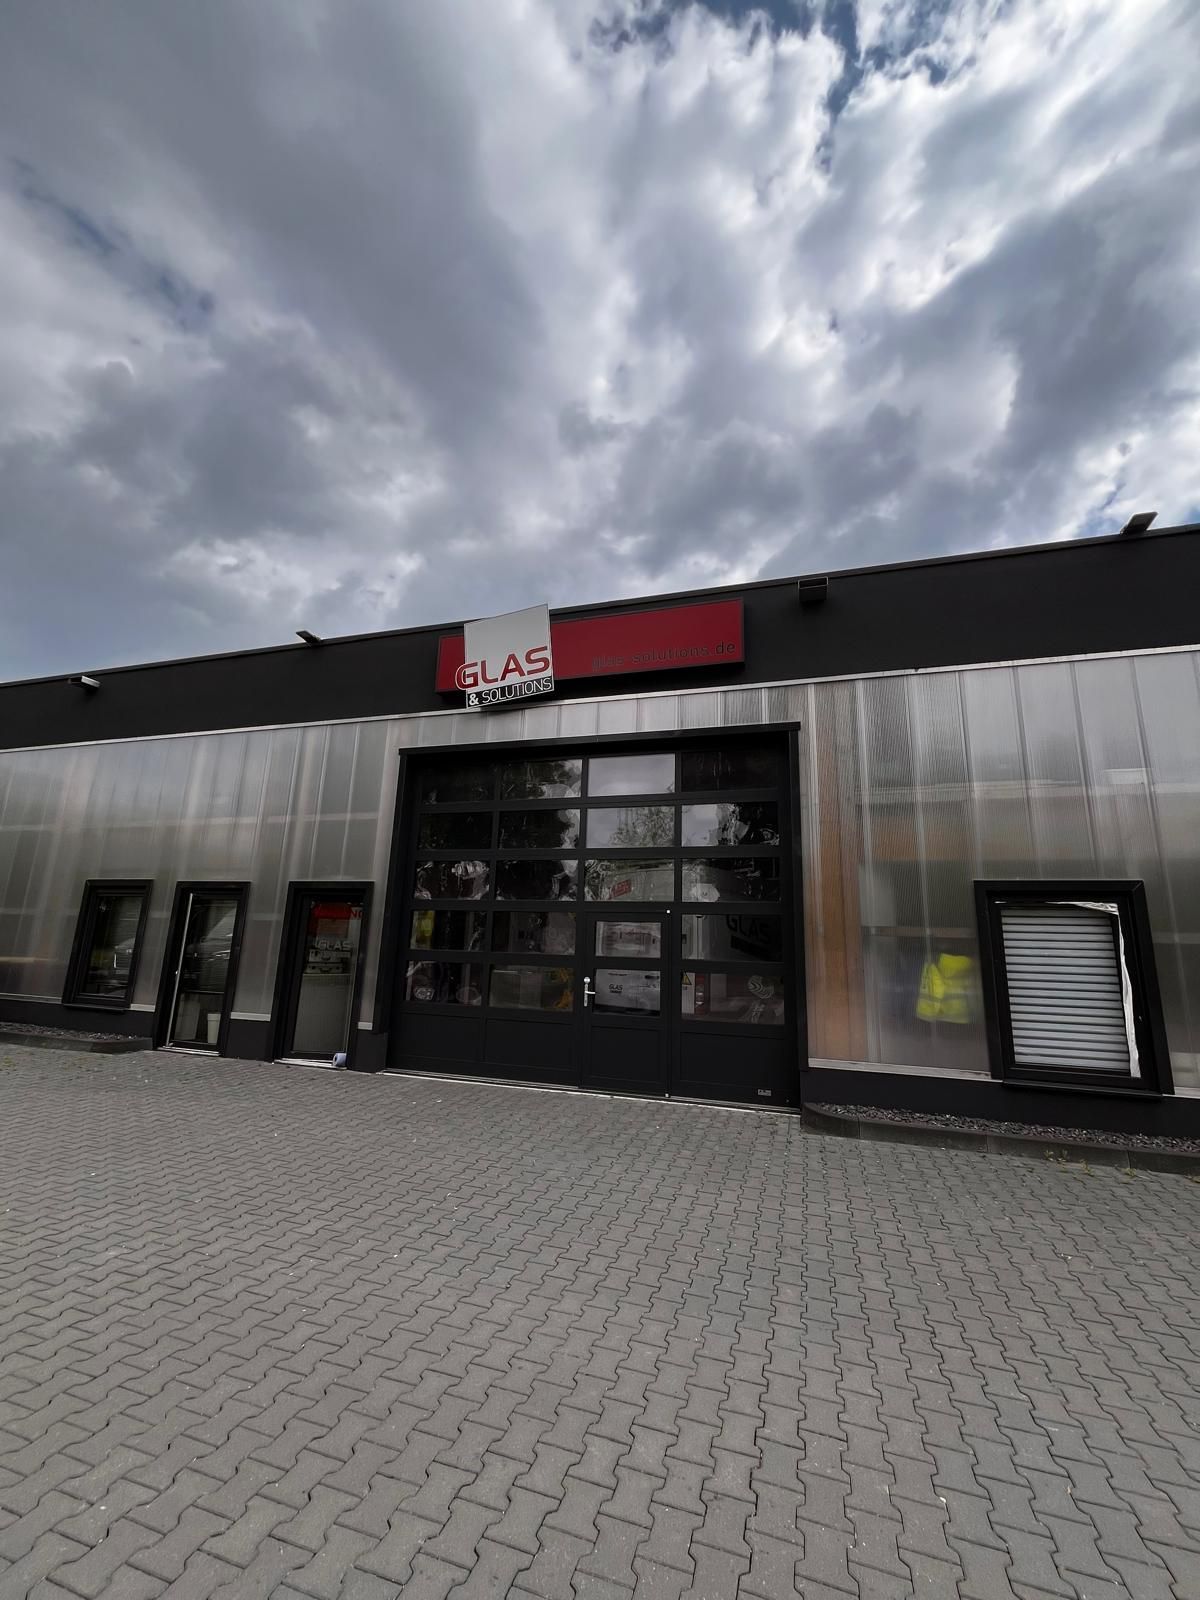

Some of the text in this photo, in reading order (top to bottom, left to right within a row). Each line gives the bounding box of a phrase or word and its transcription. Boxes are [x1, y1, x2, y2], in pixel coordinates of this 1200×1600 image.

[455, 646, 550, 690] GLAS
[592, 640, 736, 671] glassolutions.de
[469, 677, 552, 706] & SOLUTIONS
